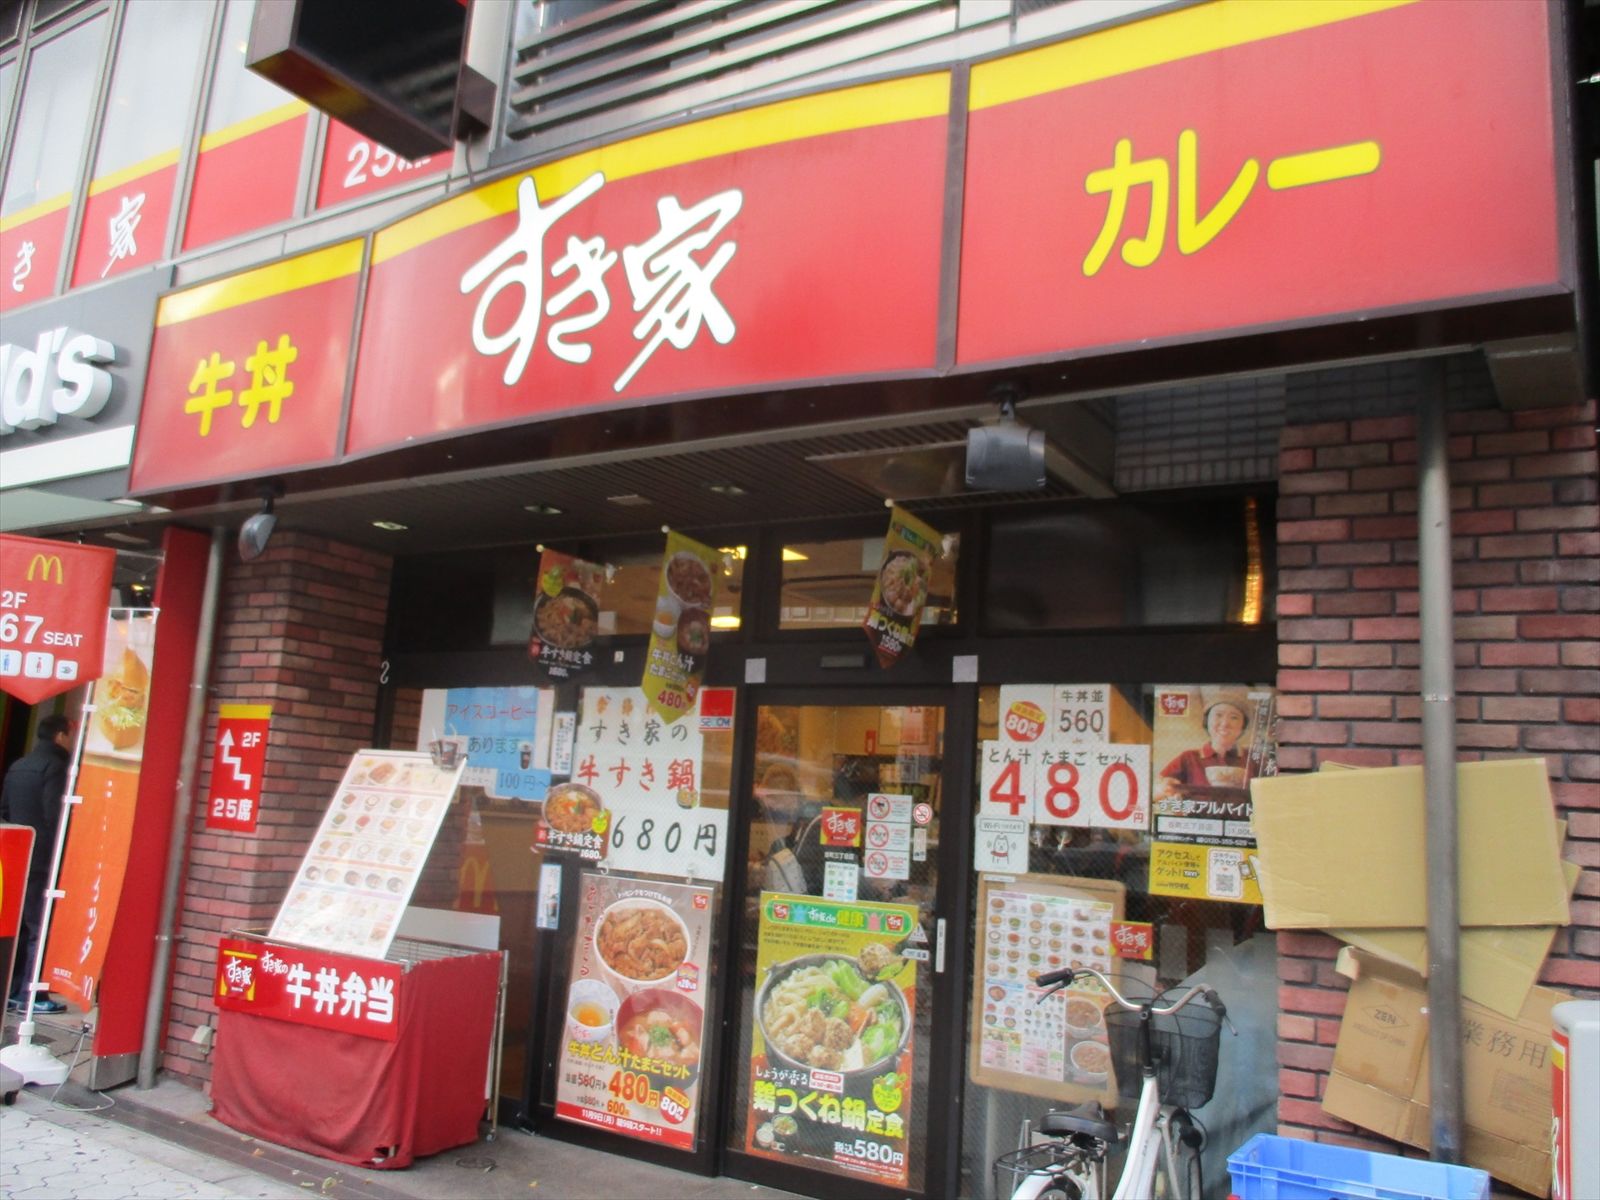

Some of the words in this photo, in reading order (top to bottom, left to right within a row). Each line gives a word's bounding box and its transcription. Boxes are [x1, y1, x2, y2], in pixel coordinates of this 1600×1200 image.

[343, 141, 432, 189] 25
[1082, 128, 1381, 277] カレー
[460, 171, 743, 393] すき家
[184, 334, 298, 437] 牛丼
[1, 591, 28, 609] 2F
[43, 631, 83, 647] SEAT
[1061, 690, 1104, 703] 牛丼並
[448, 705, 537, 721] アイスコーヒー
[1059, 709, 1104, 733] 560
[241, 732, 262, 748] 2F
[589, 720, 688, 746] すき家の
[988, 748, 1032, 765] とん汁
[1041, 750, 1088, 767] たまご
[1097, 752, 1134, 766] セット
[577, 754, 695, 792] 牛すき鍋
[213, 798, 253, 821] 25席
[1158, 800, 1254, 817] すき家アルバイト
[612, 816, 718, 857] 680円
[827, 811, 857, 837] すき家
[1114, 925, 1148, 951] すき家
[227, 956, 253, 988] すき家
[261, 950, 289, 977] すき家の
[286, 963, 394, 1023] 牛丼弁当
[1461, 1018, 1549, 1070] 業務用
[755, 1066, 808, 1085] しょうが香る
[608, 1070, 660, 1109] 480円
